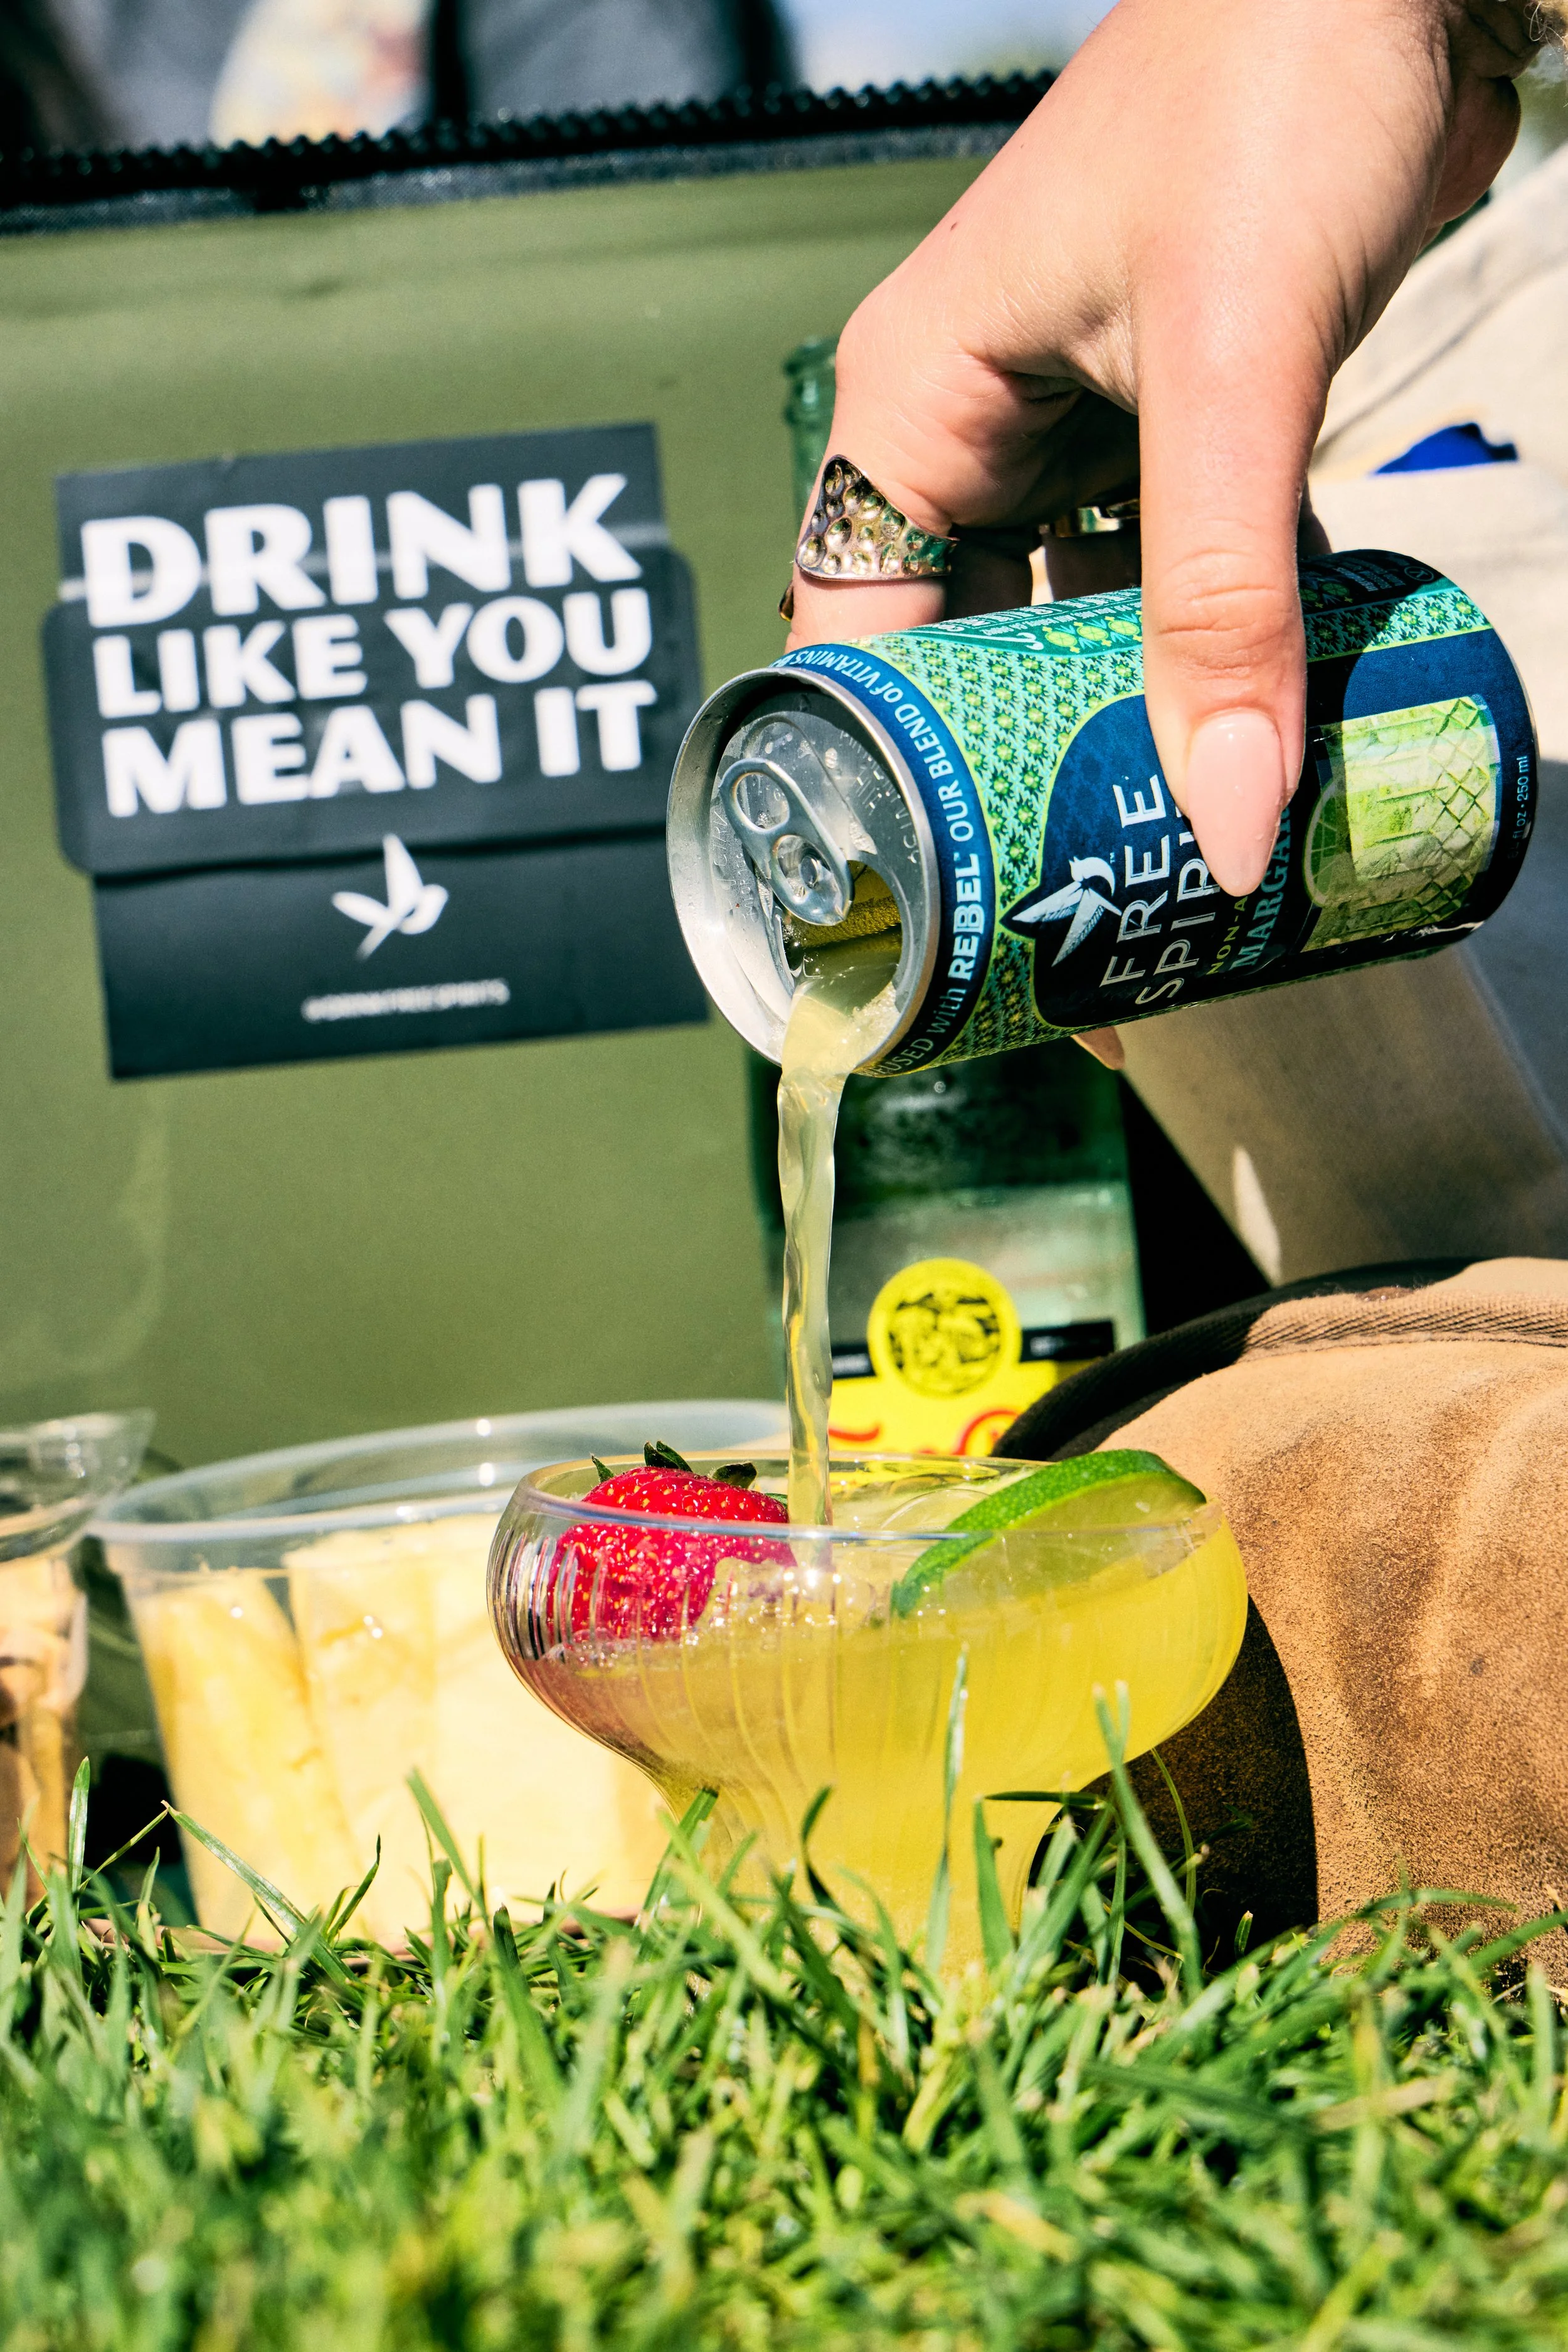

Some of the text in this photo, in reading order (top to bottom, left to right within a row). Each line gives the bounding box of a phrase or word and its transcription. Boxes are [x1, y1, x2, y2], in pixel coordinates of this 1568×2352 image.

[80, 475, 640, 627] DRINK
[94, 589, 650, 718] LIKE YOU
[790, 651, 881, 689] VITAMINS
[869, 681, 904, 703] of
[103, 681, 655, 817] MEAN IT
[894, 703, 954, 779] BLEND
[1516, 755, 1530, 774] ml
[938, 779, 974, 842] OUR
[1517, 776, 1529, 802] 250
[1517, 811, 1527, 827] oz
[1099, 774, 1170, 987] FREE
[926, 986, 967, 1034] with
